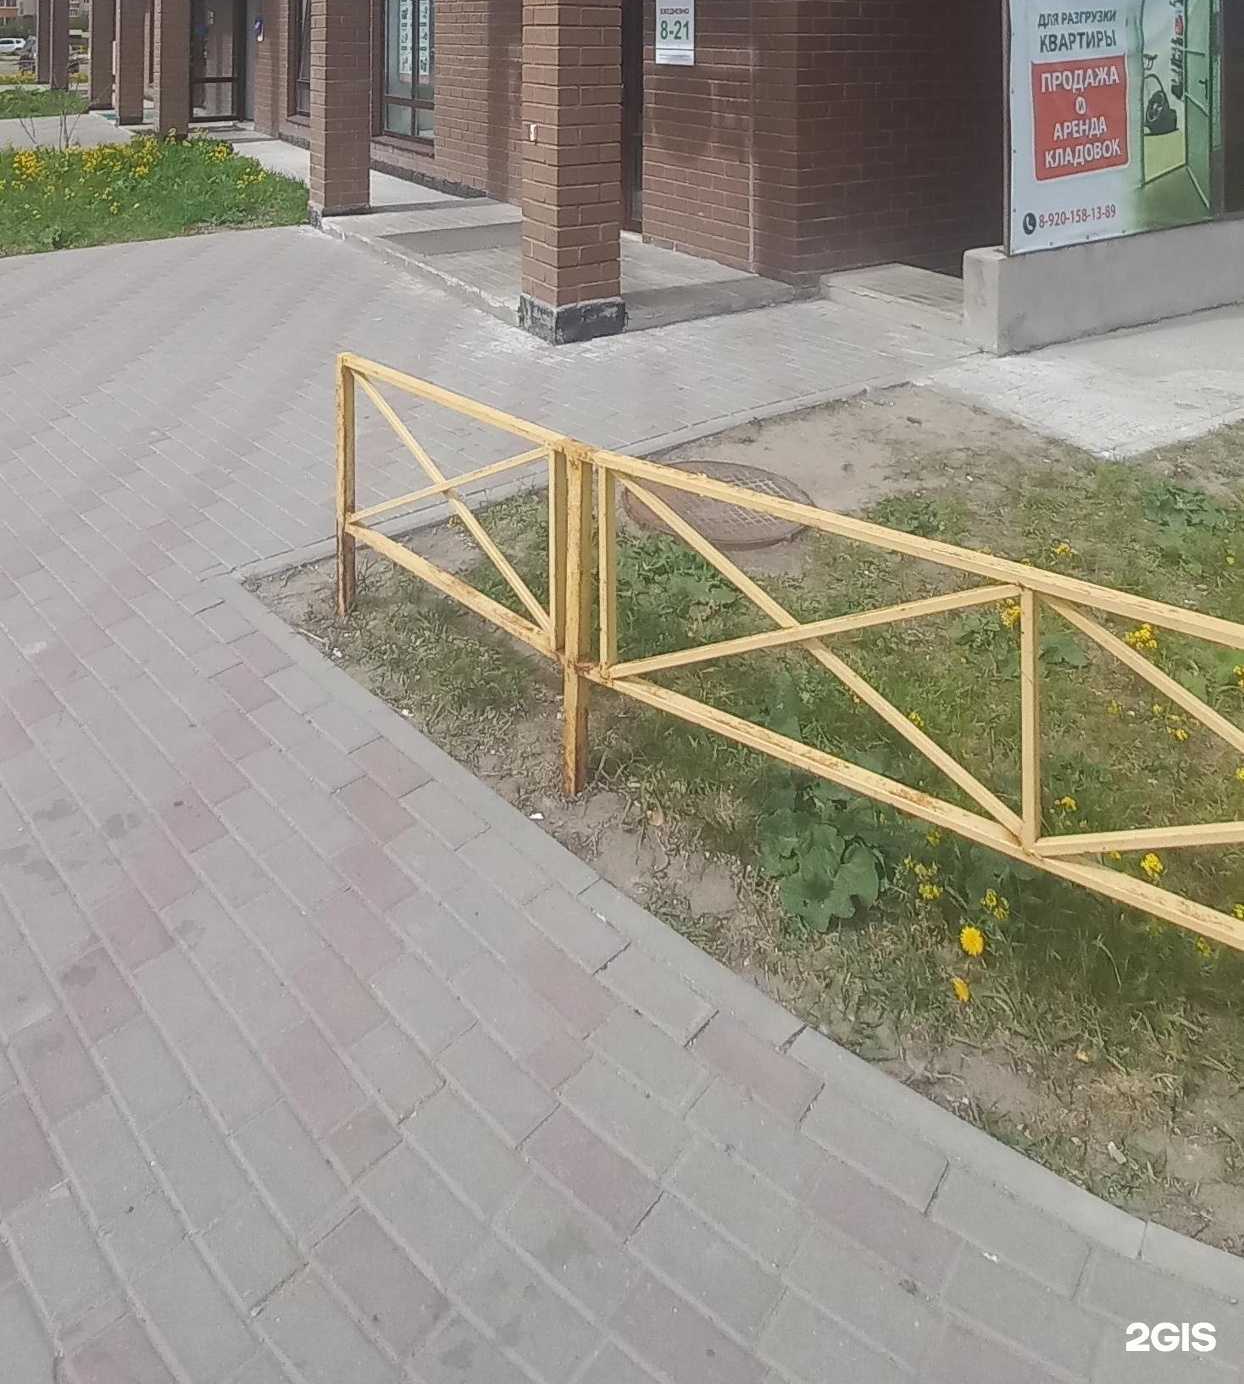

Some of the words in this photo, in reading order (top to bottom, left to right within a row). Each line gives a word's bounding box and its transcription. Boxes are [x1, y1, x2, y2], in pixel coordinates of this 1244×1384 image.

[660, 20, 689, 40] 8-21
[1038, 14, 1059, 29] ДЛЯ
[1061, 10, 1117, 26] РАЗГРУЗКИ
[1039, 29, 1117, 53] КВАРТИРЫ
[1041, 66, 1120, 93] ПРОДАЖА
[1053, 117, 1107, 141] АРЕНДА
[1045, 139, 1121, 169] КЛАДОВОК
[1038, 204, 1116, 229] 8-920-158-13-89
